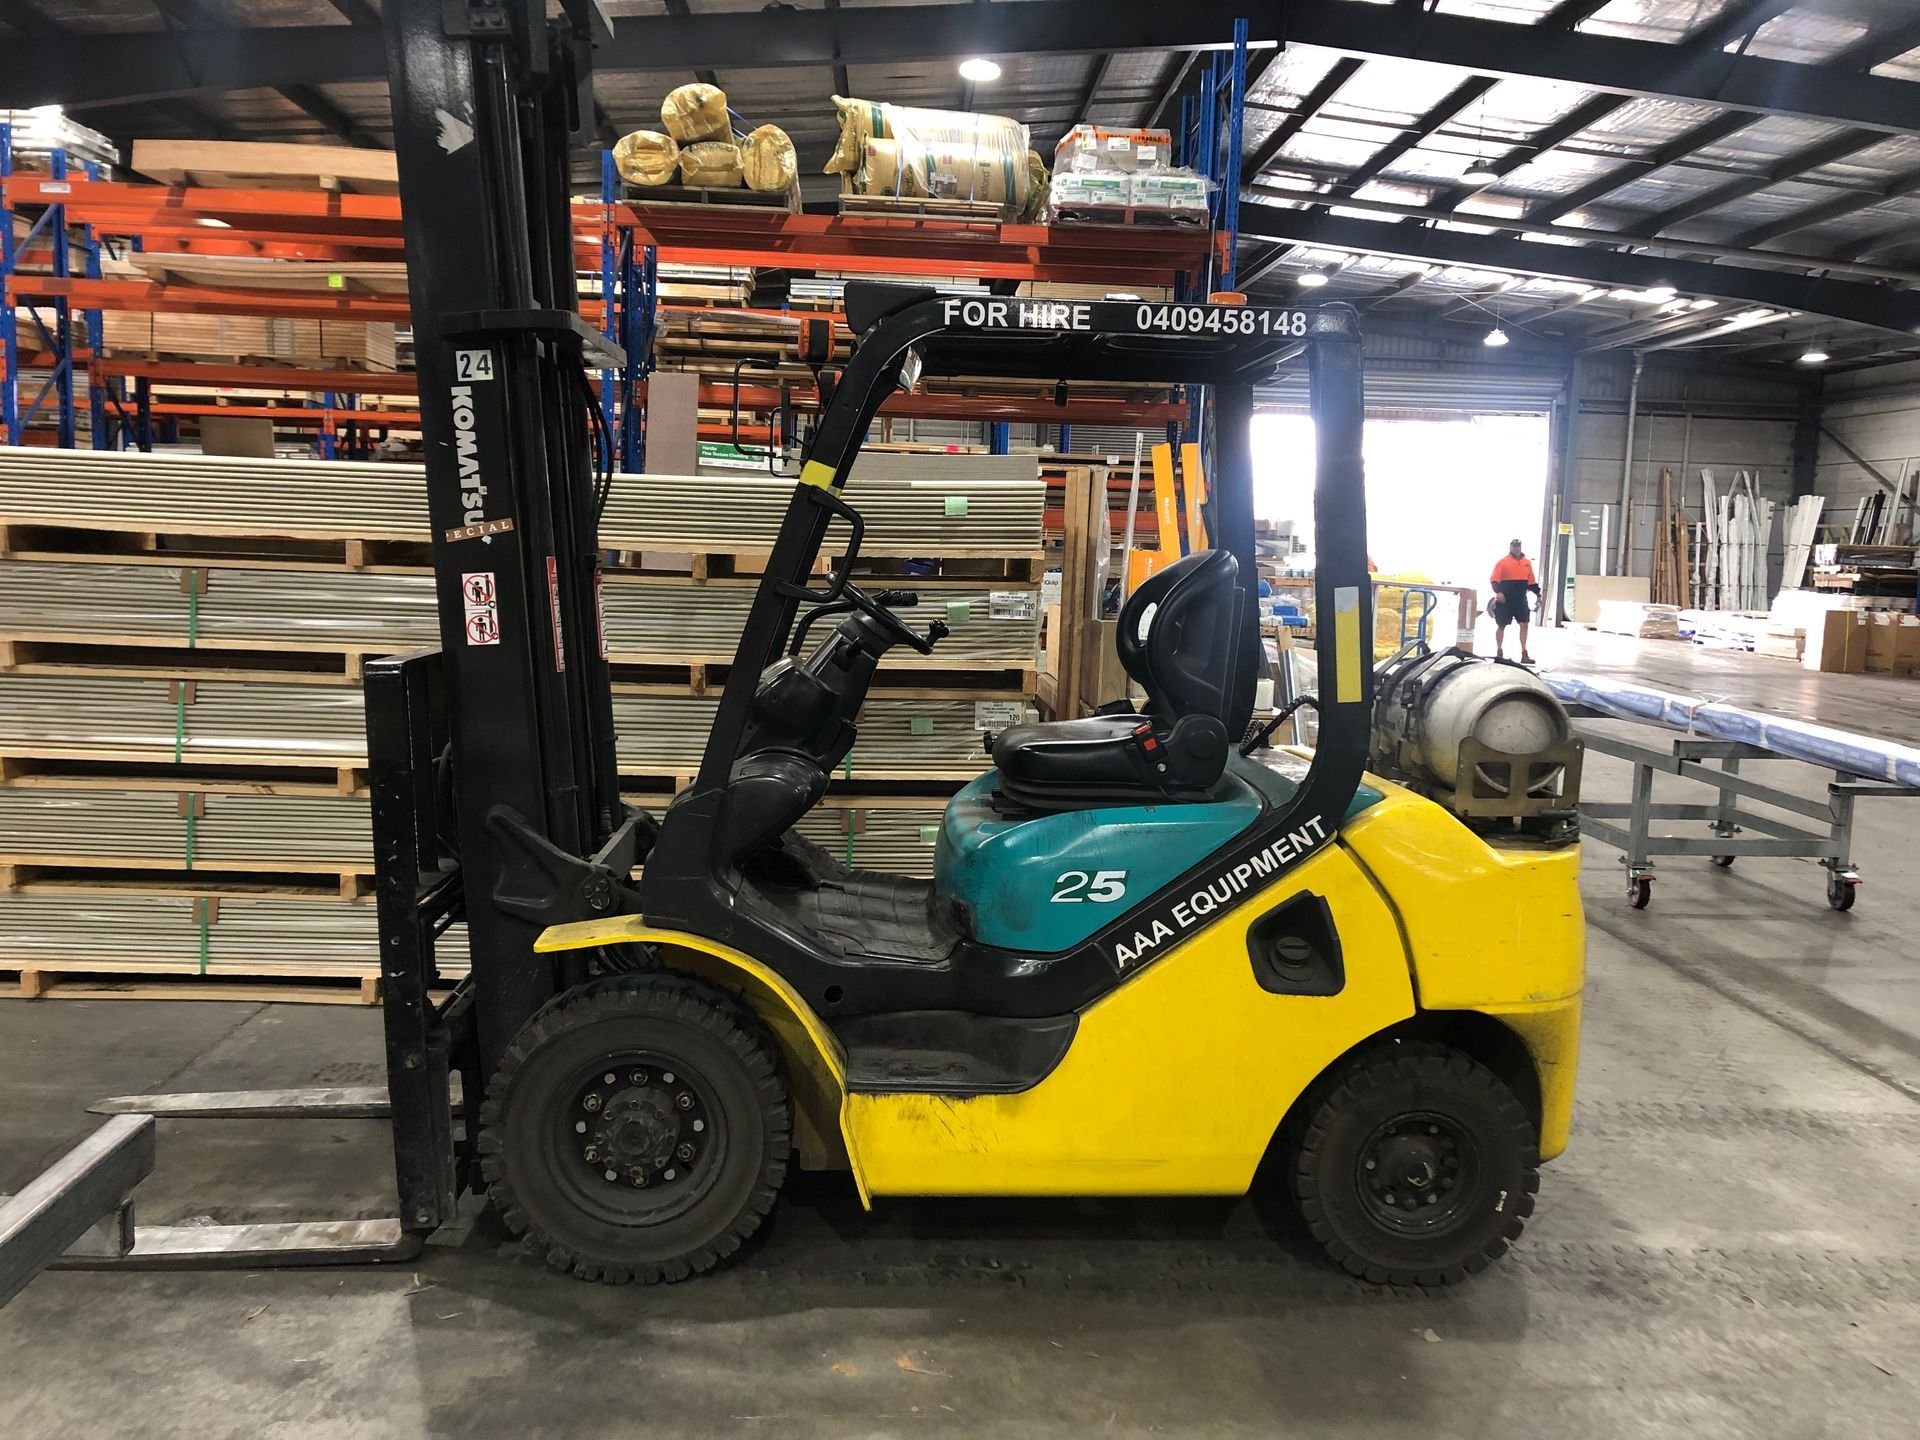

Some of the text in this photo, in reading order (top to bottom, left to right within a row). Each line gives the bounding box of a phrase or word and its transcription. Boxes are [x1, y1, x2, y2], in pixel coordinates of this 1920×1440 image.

[944, 301, 1091, 331] FOR HIRE
[1136, 305, 1307, 336] 0409458148
[459, 353, 491, 378] 24
[450, 386, 485, 527] KOMATSU
[1024, 602, 1035, 610] 120
[1009, 713, 1020, 721] 120
[1050, 870, 1127, 903] 25
[1114, 814, 1329, 968] AAA EQUIPMENT
